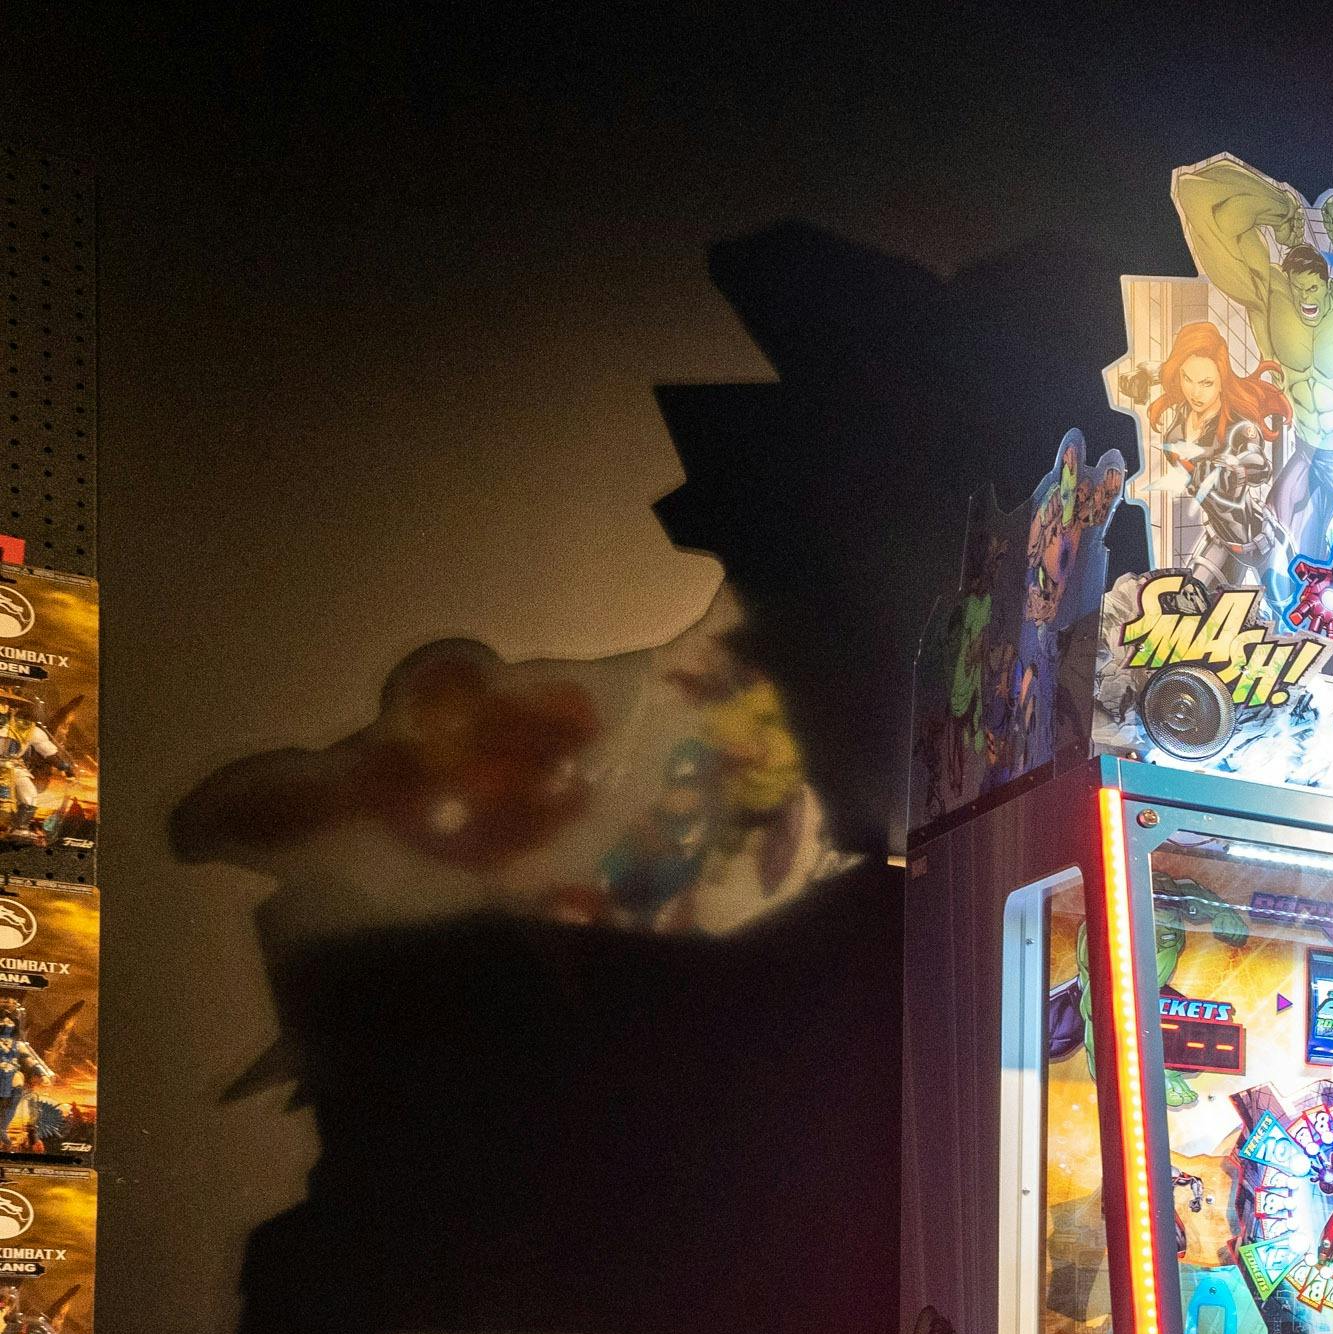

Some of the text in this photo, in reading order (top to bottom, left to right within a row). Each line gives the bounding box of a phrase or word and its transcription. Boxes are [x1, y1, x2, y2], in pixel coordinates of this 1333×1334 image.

[1122, 575, 1323, 707] SMASH!
[58, 655, 69, 668] X
[59, 963, 70, 974] X
[56, 1249, 67, 1261] X
